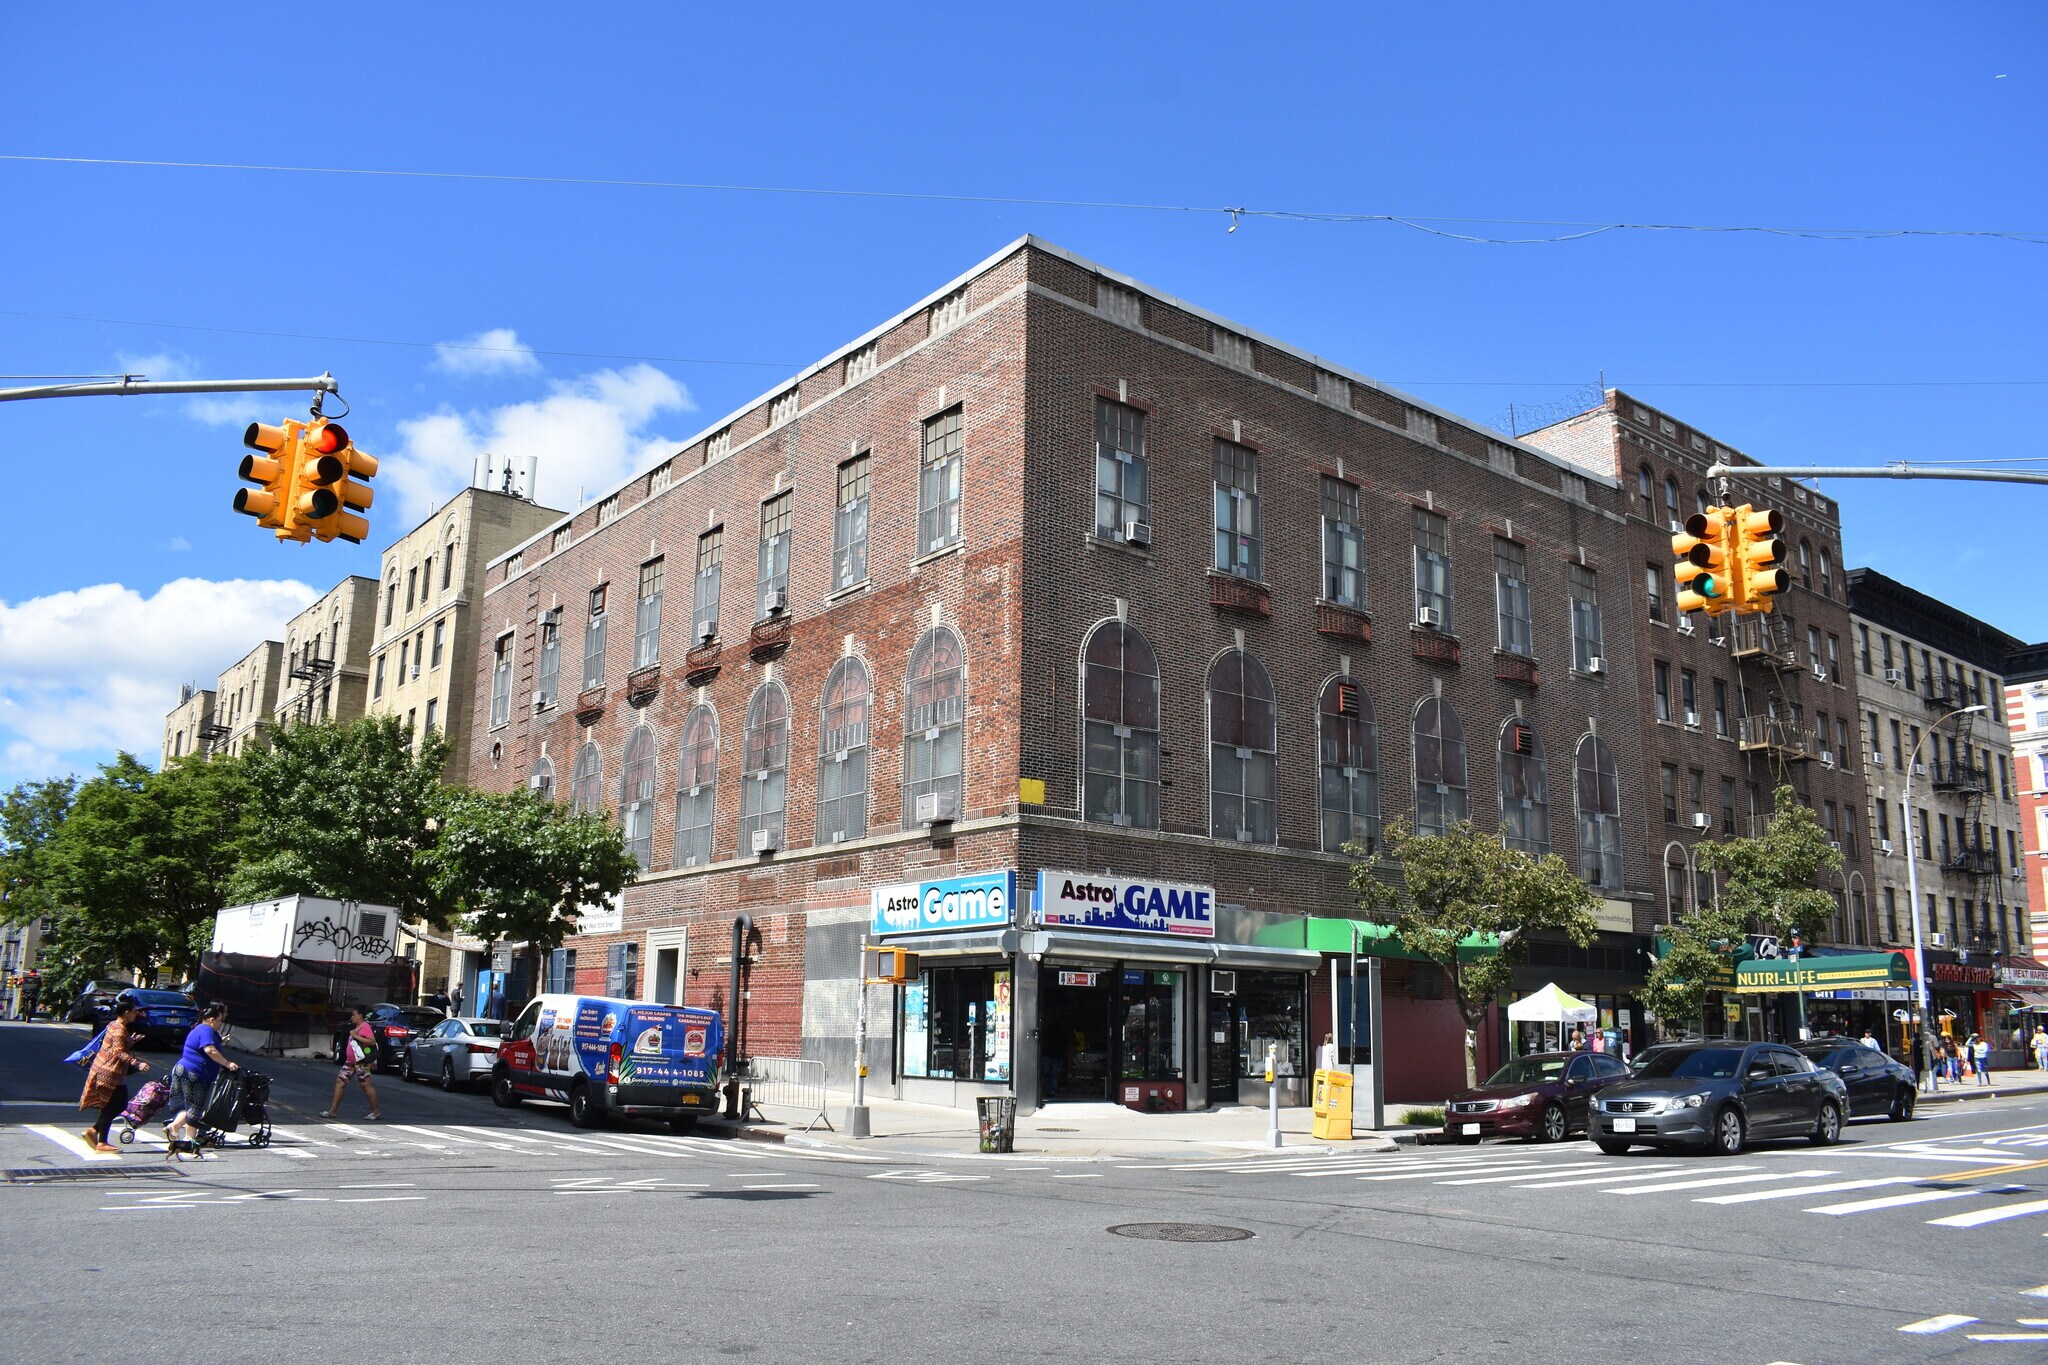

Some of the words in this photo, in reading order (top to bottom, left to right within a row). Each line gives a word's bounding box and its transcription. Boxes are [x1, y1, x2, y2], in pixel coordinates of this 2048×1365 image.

[887, 896, 919, 912] Astro
[923, 886, 1005, 924] Game
[1060, 879, 1114, 903] Astro
[1123, 885, 1210, 921] GAME
[1737, 970, 1816, 985] NUTRI-LIFE
[1934, 963, 1994, 984] BARBERSHOP
[2013, 969, 2028, 979] MEAT
[581, 1042, 608, 1052] 917-444-1085
